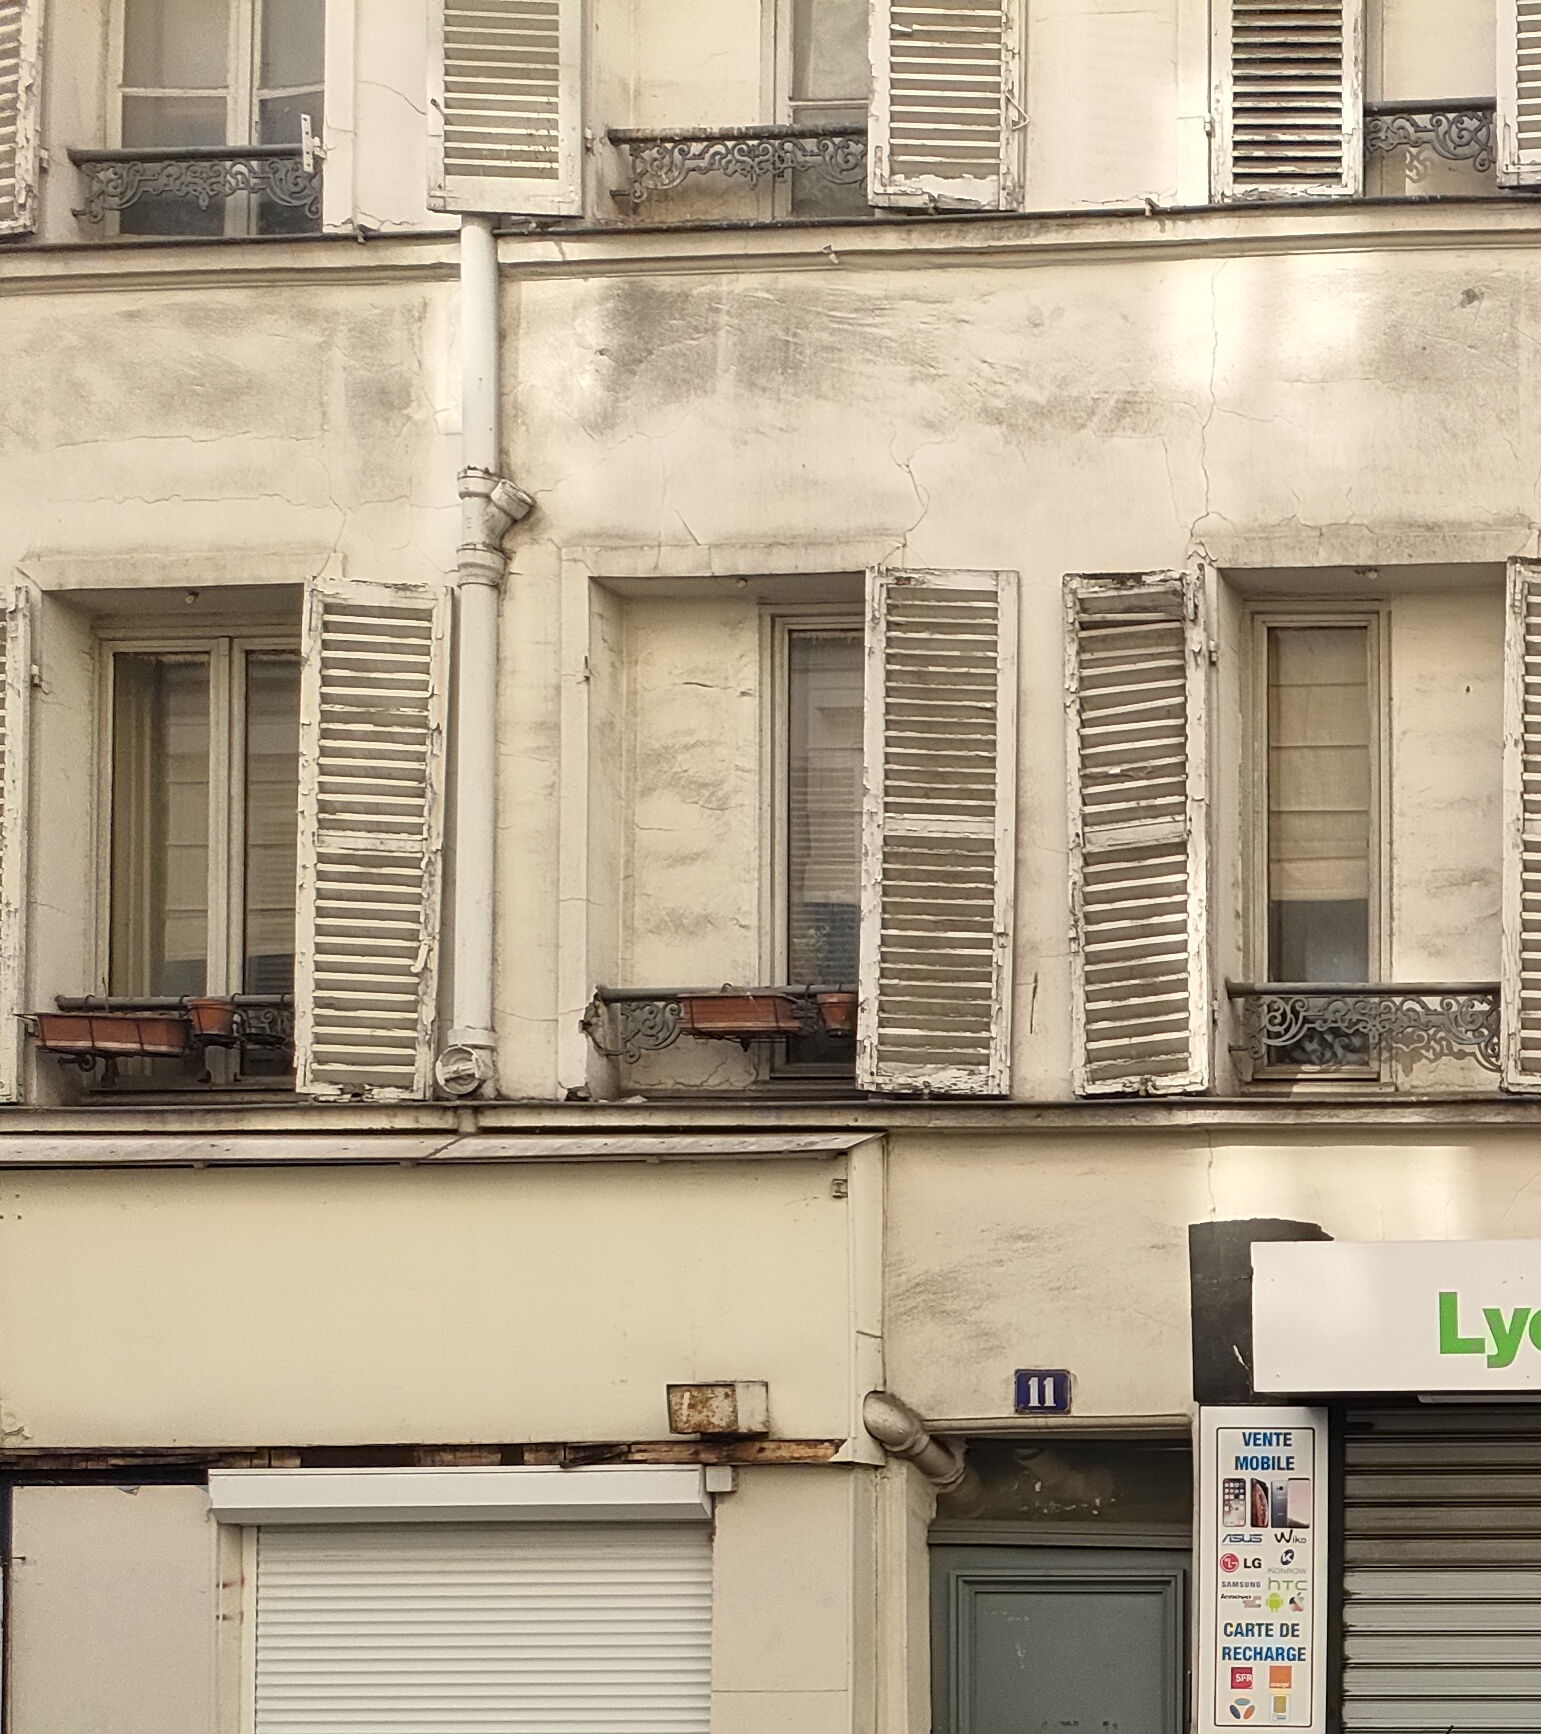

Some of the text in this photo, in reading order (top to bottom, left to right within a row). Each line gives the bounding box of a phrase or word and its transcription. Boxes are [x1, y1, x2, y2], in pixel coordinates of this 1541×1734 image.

[1027, 1376, 1056, 1407] 11
[1241, 1432, 1292, 1447] VENTE
[1234, 1456, 1295, 1471] MOBILE
[1222, 1528, 1307, 1544] ASUS Wiko
[1243, 1557, 1262, 1569] LG
[1223, 1622, 1300, 1638] CARTE DE
[1221, 1646, 1307, 1662] RECHARGE
[1235, 1673, 1253, 1682] SFR
